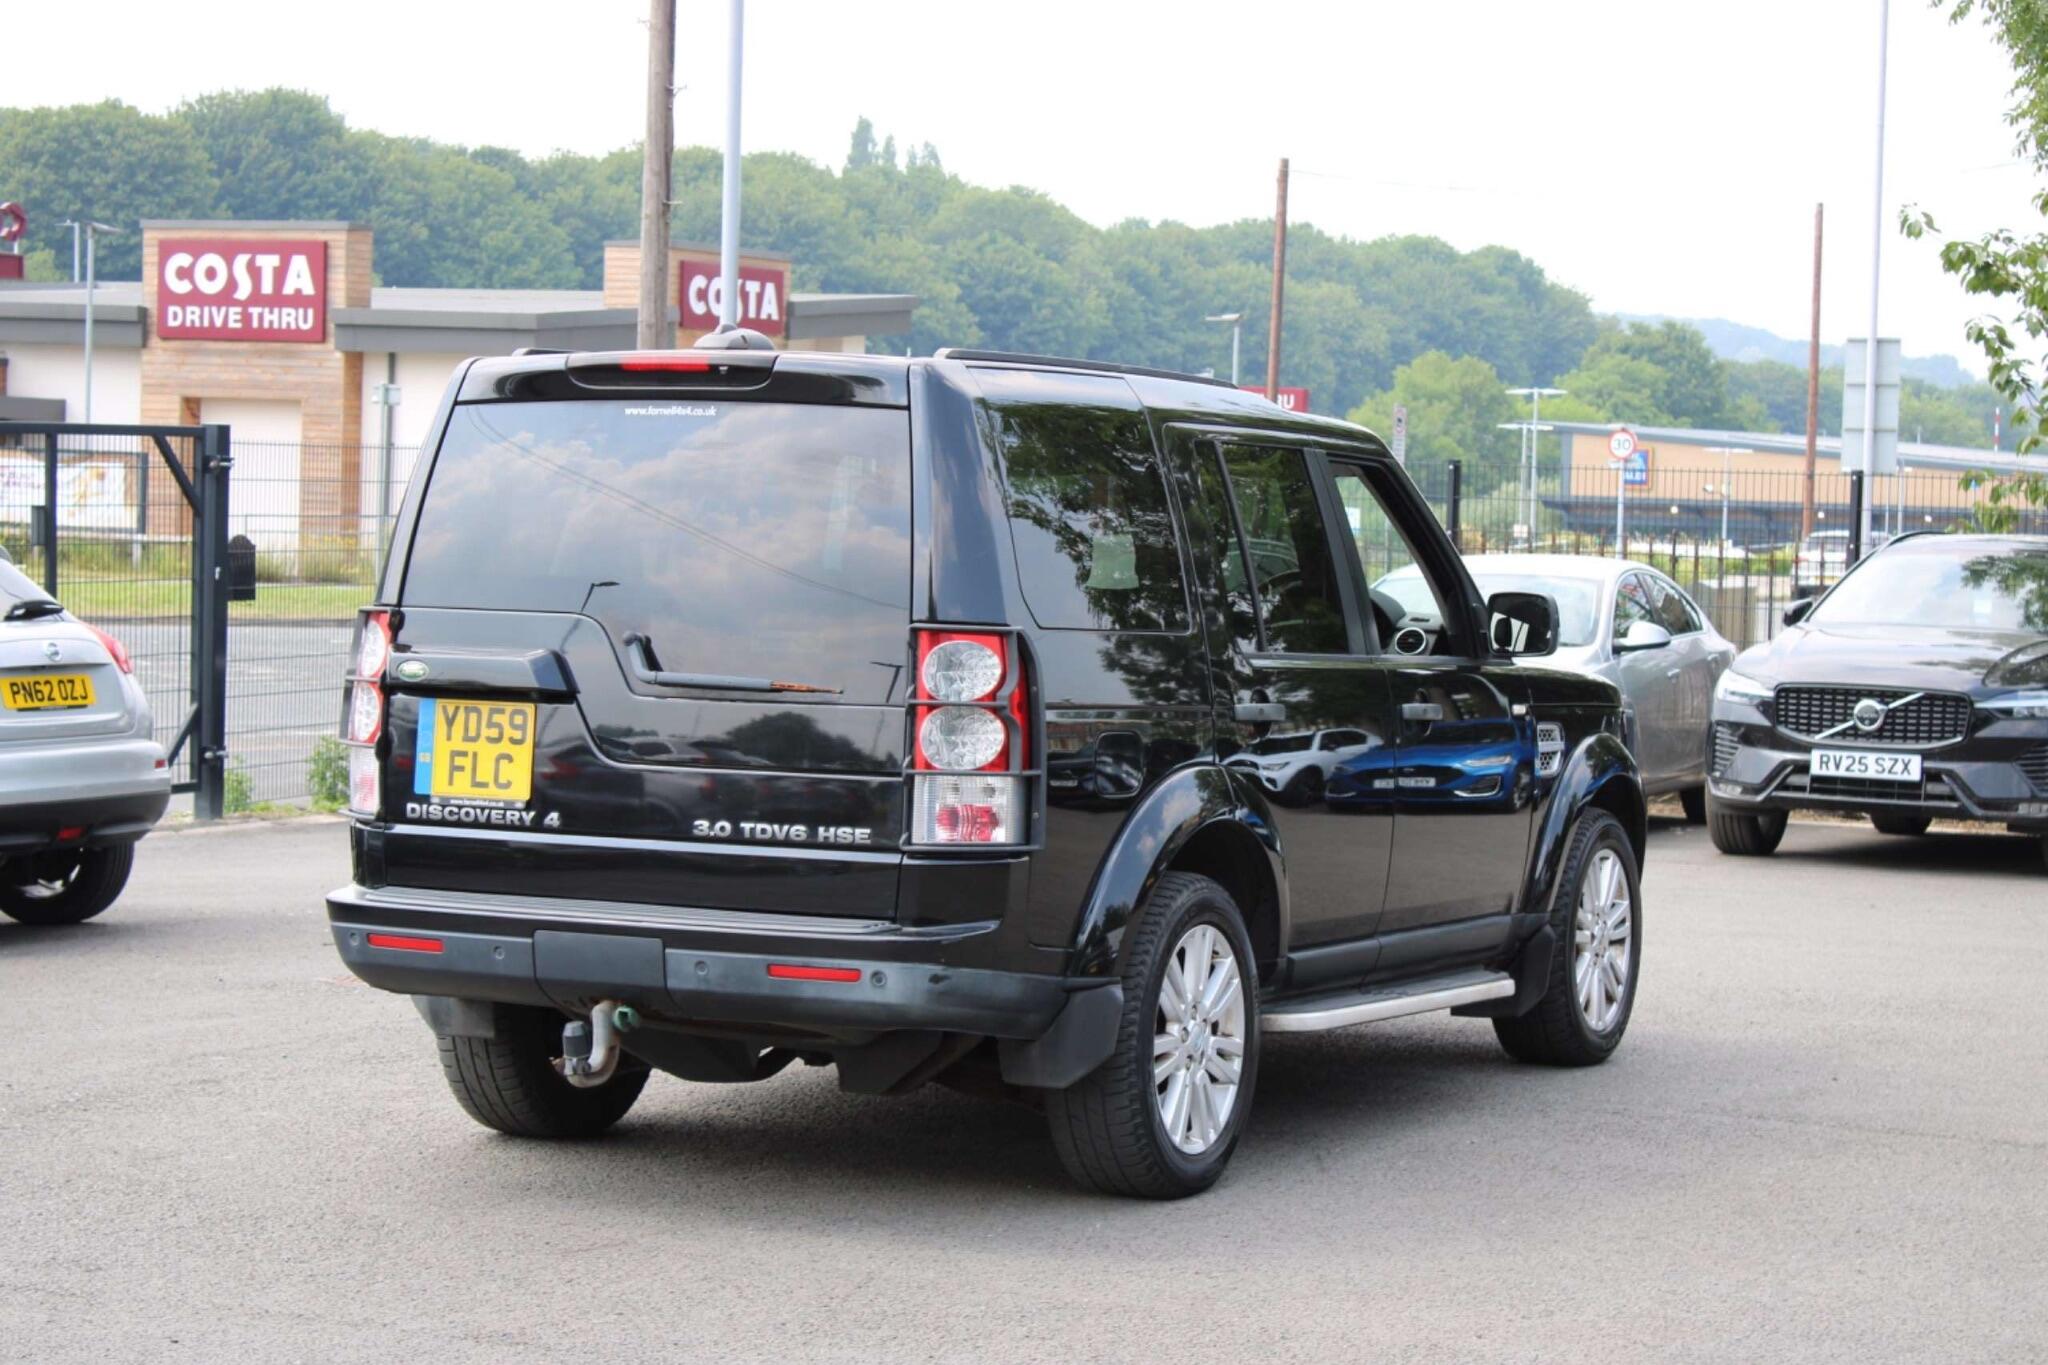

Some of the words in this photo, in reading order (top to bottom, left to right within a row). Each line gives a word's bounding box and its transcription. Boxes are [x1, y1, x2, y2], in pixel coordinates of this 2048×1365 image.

[163, 252, 315, 301] COSTA
[166, 305, 243, 328] DRIVE
[248, 307, 314, 330] THRU
[1613, 438, 1632, 450] 30
[9, 680, 57, 705] PN62
[57, 678, 89, 701] OZJ
[441, 705, 529, 746] YD59
[447, 750, 514, 791] FLC
[1819, 754, 1869, 773] RV25
[1874, 756, 1912, 776] SZX
[406, 802, 537, 826] DISCOVERY
[543, 812, 561, 829] 4
[692, 819, 732, 838] 3.0
[739, 821, 808, 842] TDV6
[817, 825, 872, 845] HSE
